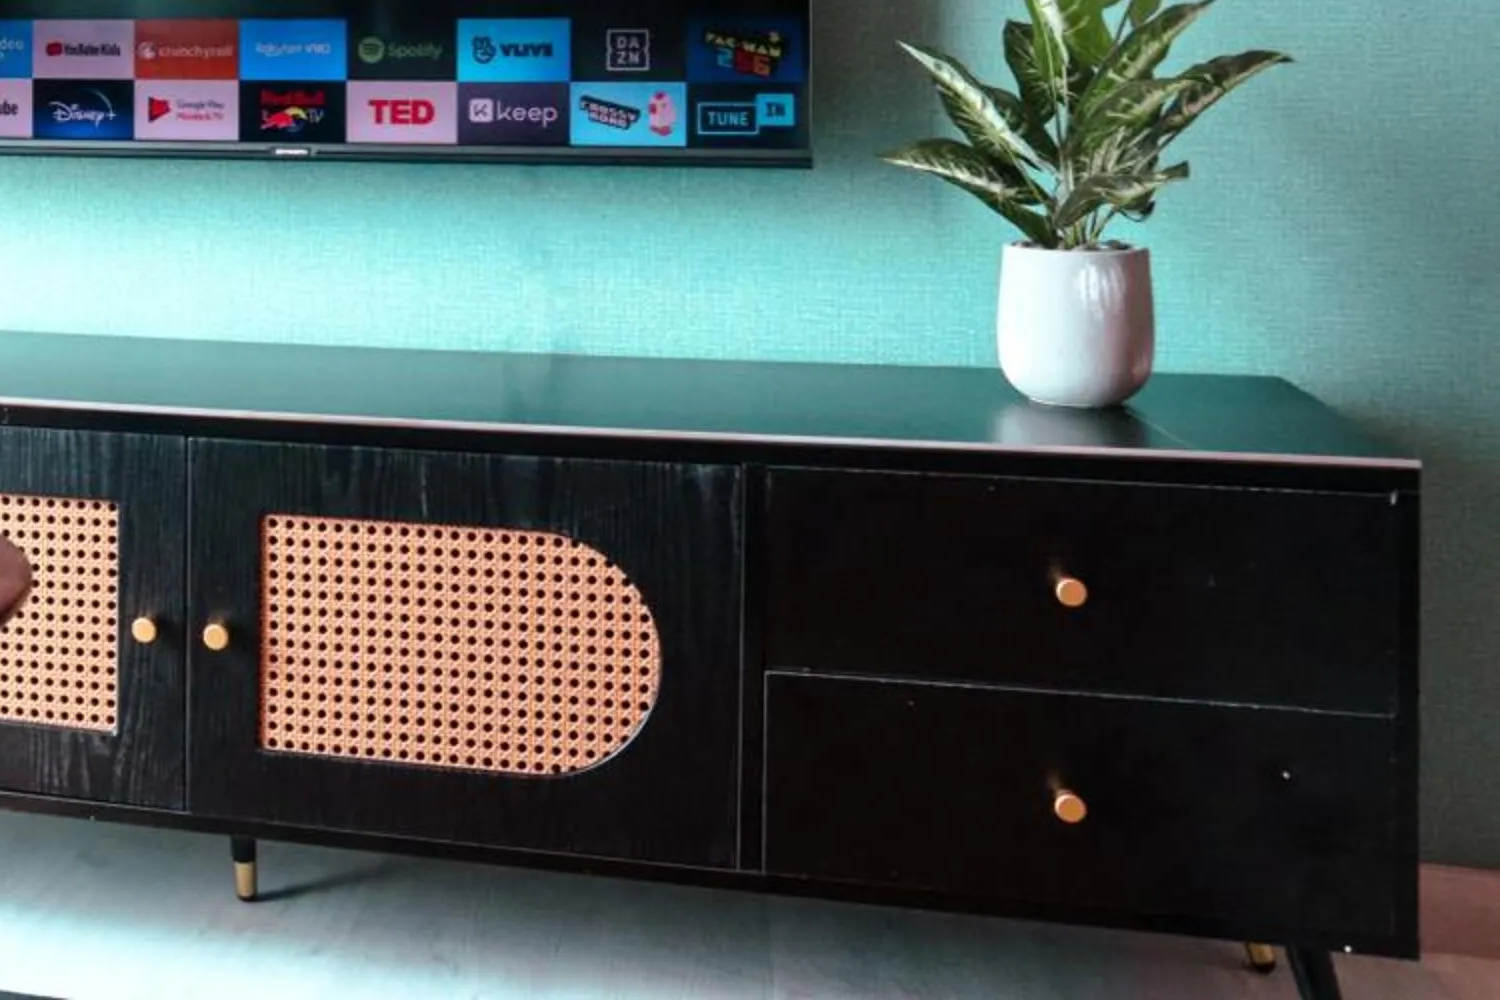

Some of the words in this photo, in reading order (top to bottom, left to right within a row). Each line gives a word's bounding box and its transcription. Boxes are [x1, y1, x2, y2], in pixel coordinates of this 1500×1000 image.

[100, 43, 121, 56] Kids
[388, 41, 443, 60] Spotify
[616, 36, 640, 49] DA
[49, 100, 116, 127] Disney+
[368, 98, 435, 125] TED
[496, 100, 559, 128] keep
[707, 111, 749, 126] TUNE
